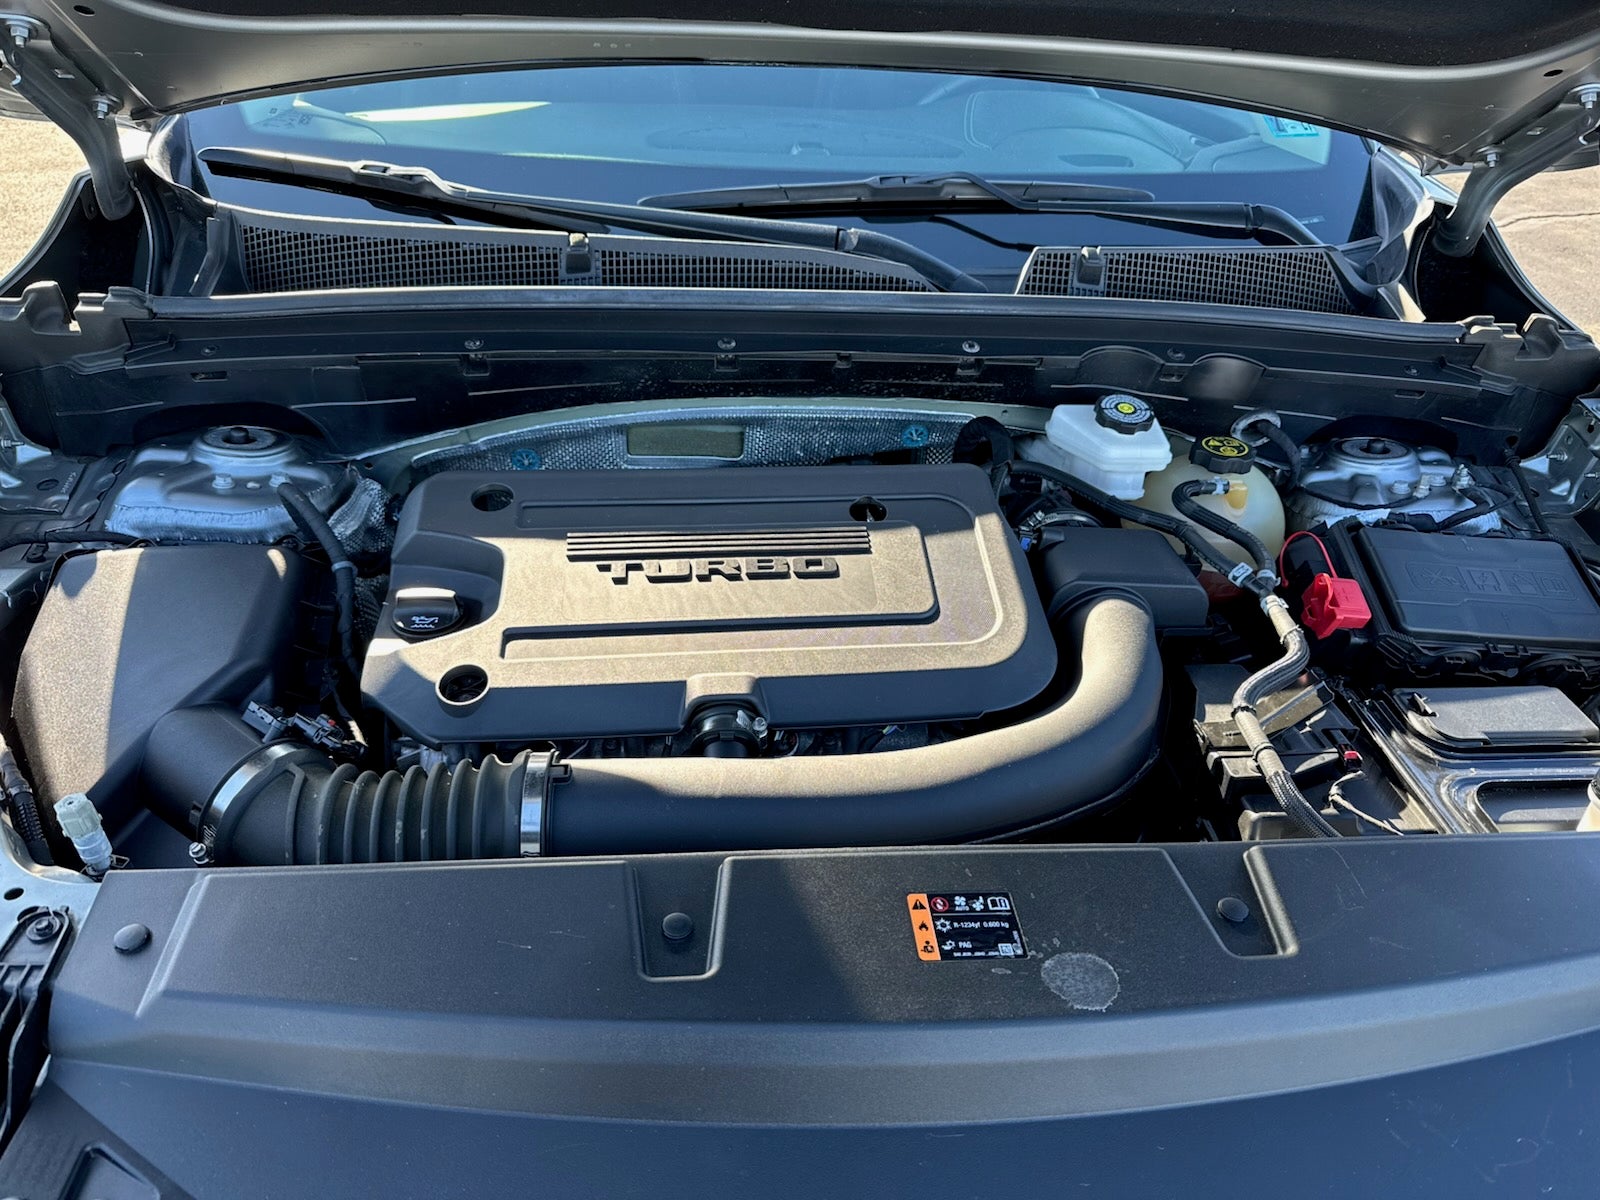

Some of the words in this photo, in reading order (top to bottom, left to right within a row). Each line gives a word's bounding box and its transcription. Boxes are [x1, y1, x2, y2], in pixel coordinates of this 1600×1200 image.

[596, 557, 840, 585] TURBO
[953, 921, 981, 929] R-1234yf
[1000, 921, 1010, 929] kg
